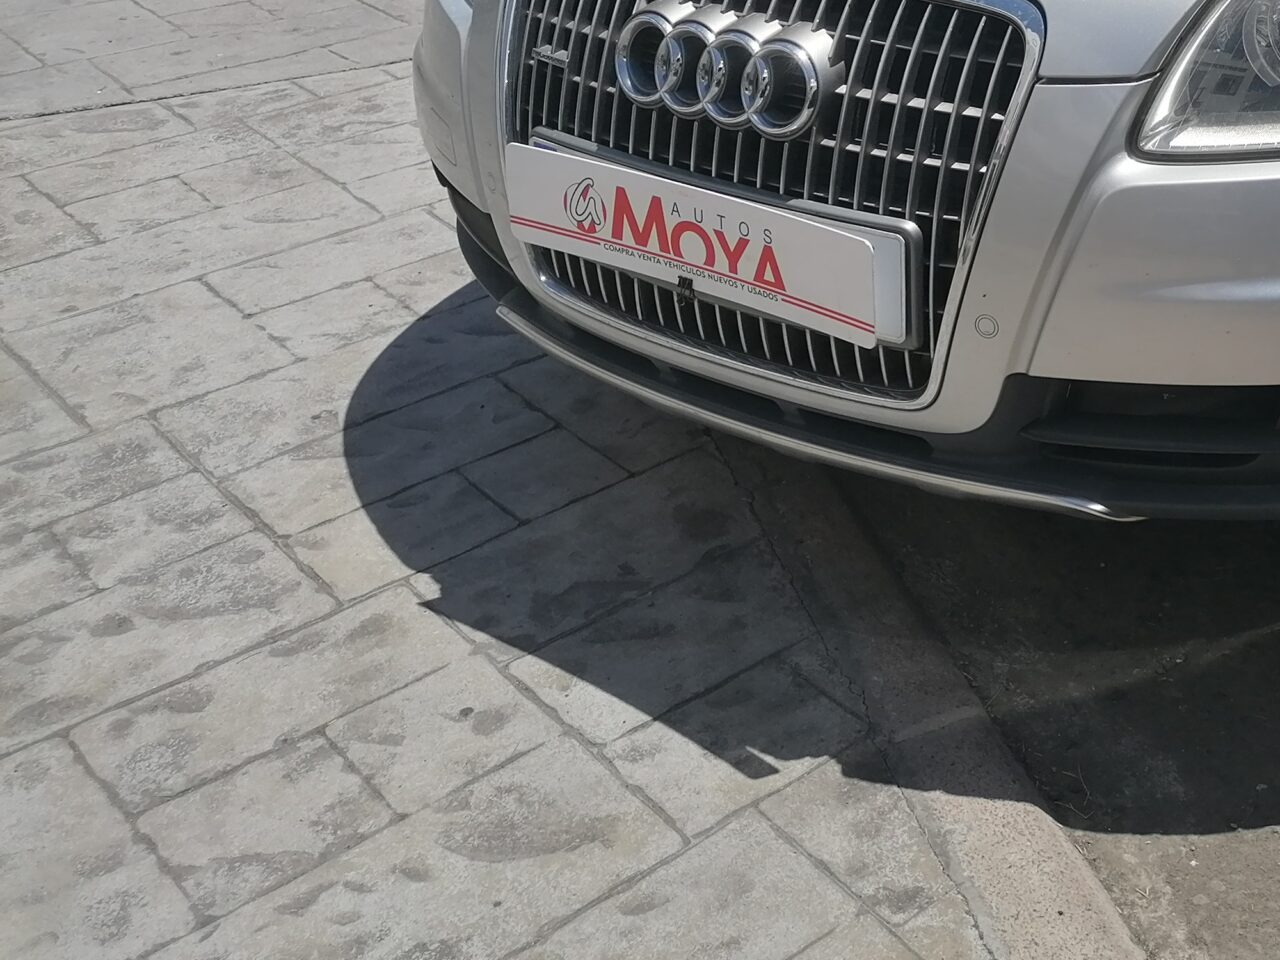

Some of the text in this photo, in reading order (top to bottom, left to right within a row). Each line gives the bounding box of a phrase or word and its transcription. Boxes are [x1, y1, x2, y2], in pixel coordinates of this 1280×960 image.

[611, 185, 788, 292] MOYA
[670, 201, 773, 245] AUTOS
[603, 243, 779, 302] COMPRA VENTA VEHICULOS NUEVOS Y USADOS
